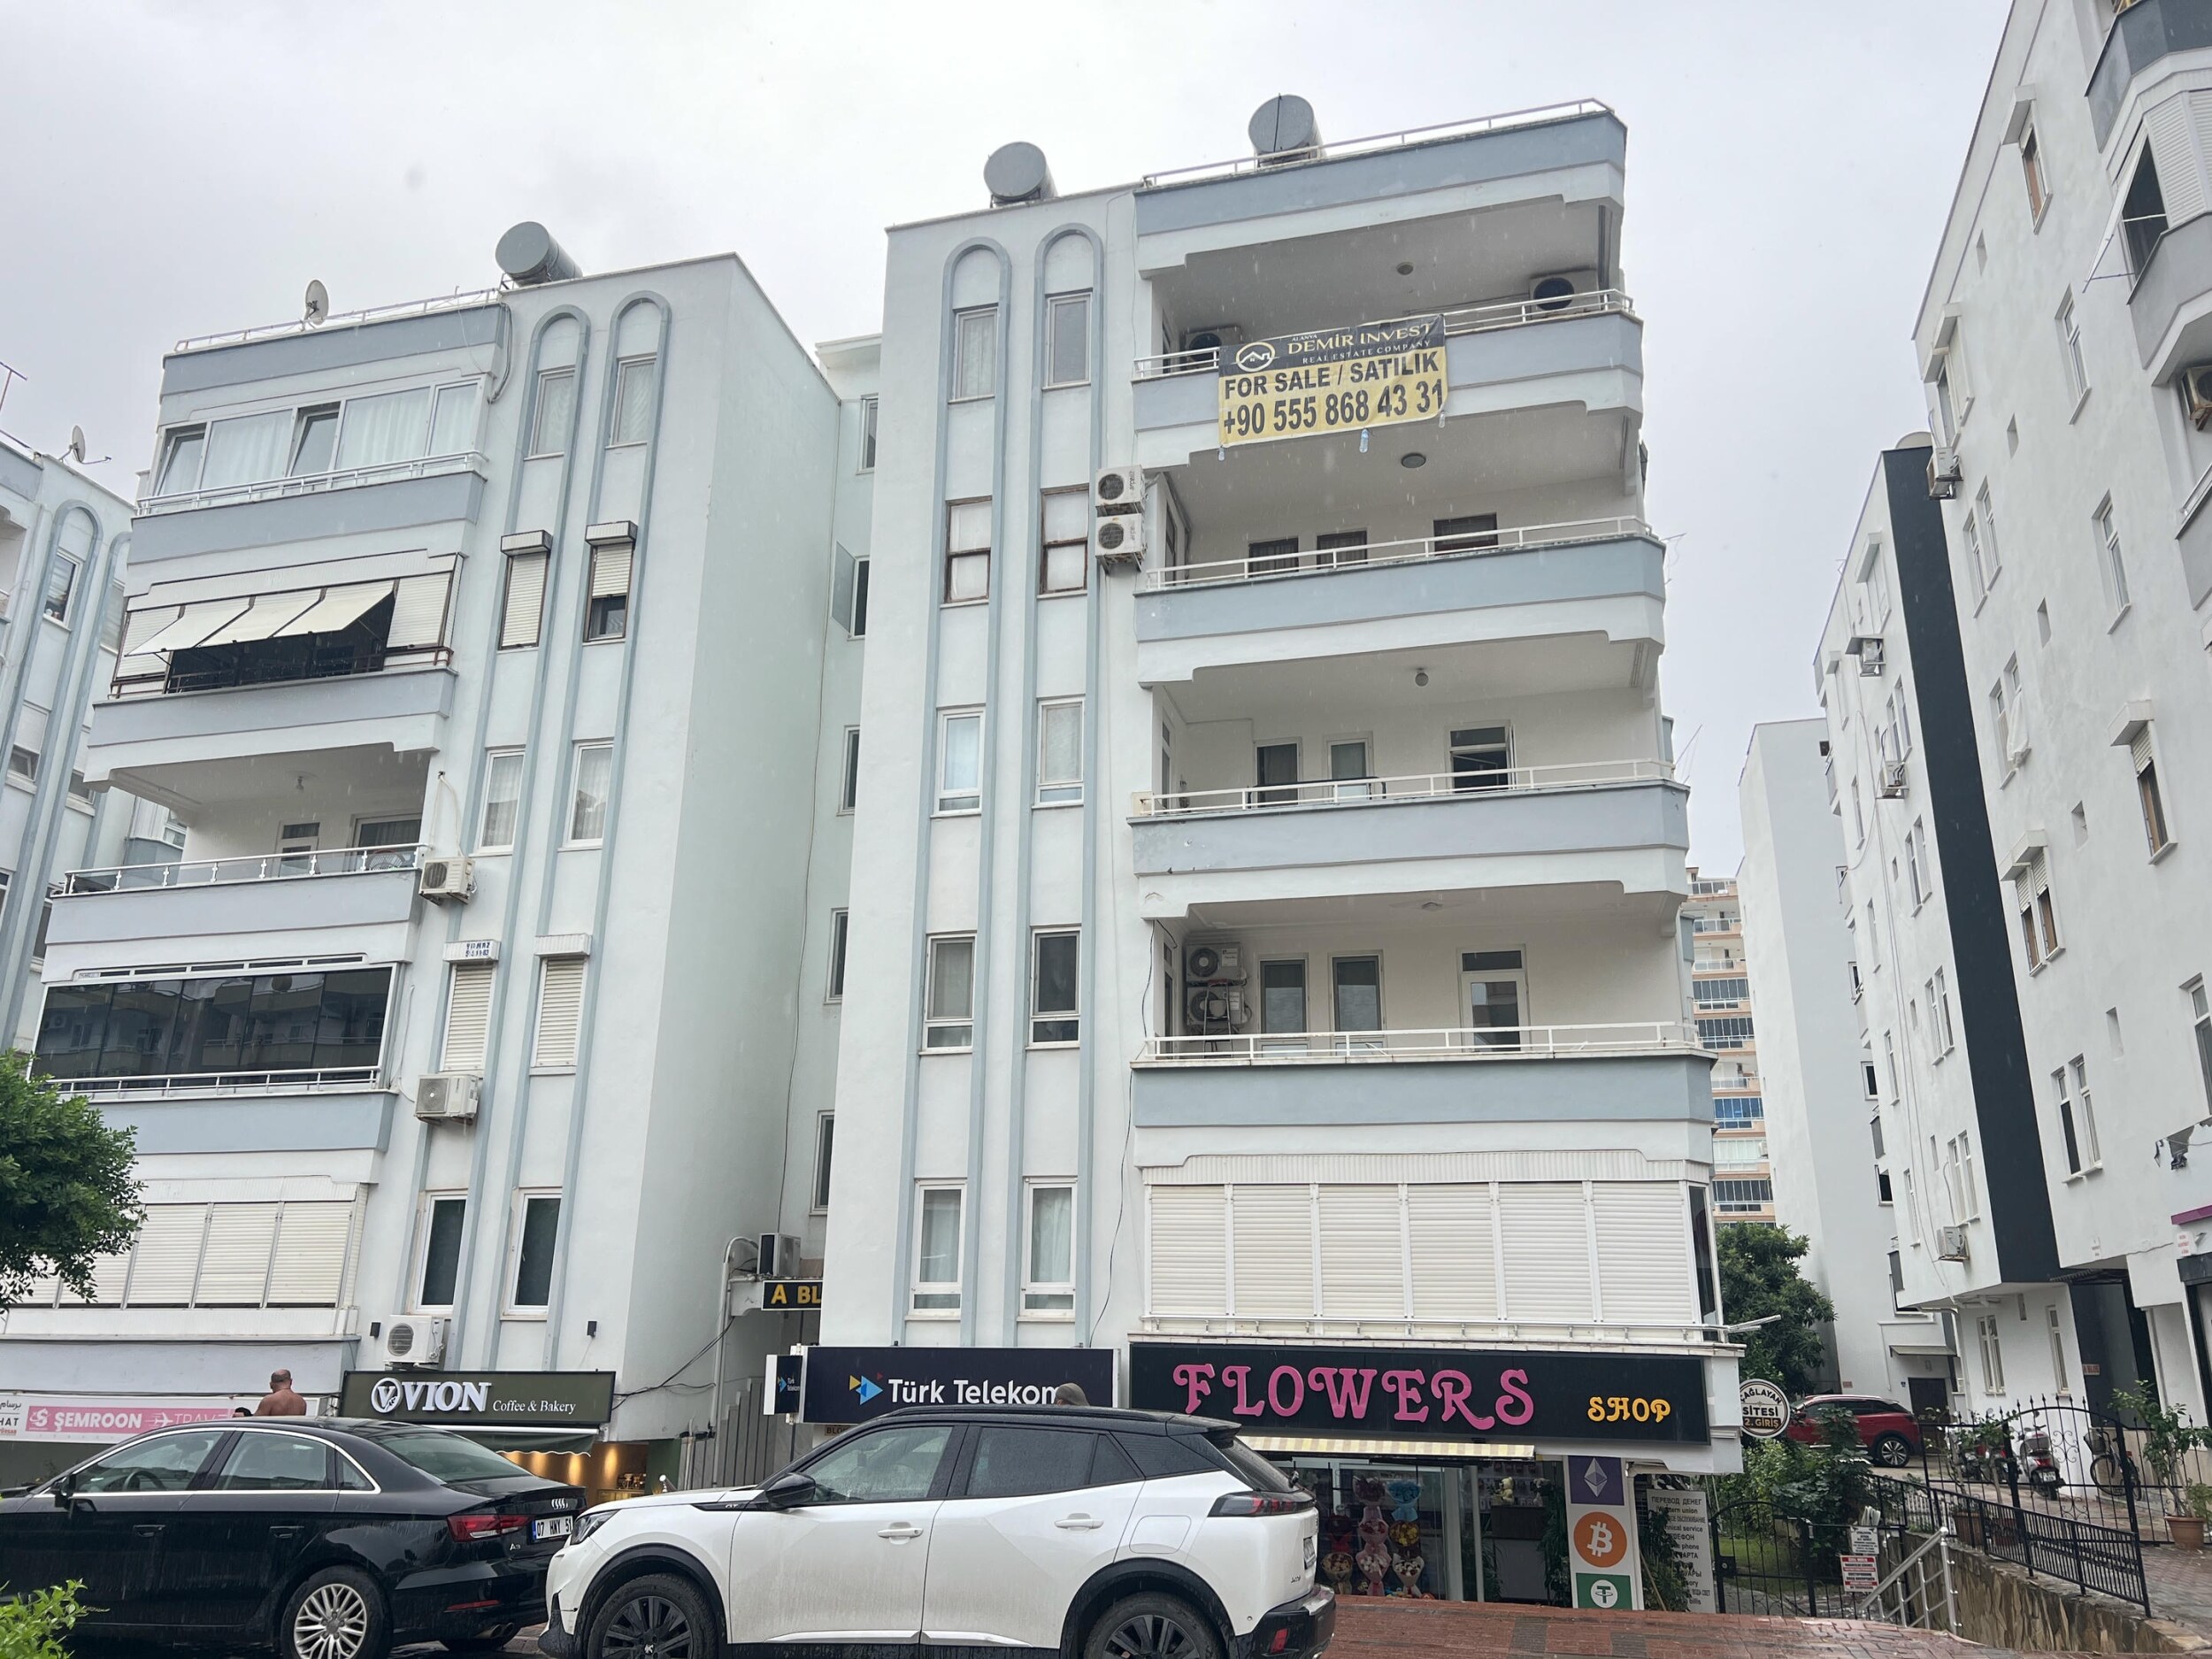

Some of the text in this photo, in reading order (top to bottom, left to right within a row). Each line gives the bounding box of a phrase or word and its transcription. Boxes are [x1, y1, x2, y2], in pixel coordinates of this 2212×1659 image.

[1287, 323, 1432, 355] DEMİR INVEST
[1302, 340, 1431, 365] REAL ESTATE COMPANY
[1225, 375, 1267, 399] FOR
[1274, 367, 1331, 392] SALE
[1350, 351, 1439, 383] SATILIK
[1224, 378, 1443, 436] +90 555 868 43 31
[771, 1283, 822, 1304] A BL
[402, 1380, 492, 1412] VION
[493, 1399, 526, 1412] Coffee
[527, 1400, 538, 1412] &
[540, 1400, 576, 1415] Bakery
[887, 1379, 945, 1404] Türk
[1173, 1363, 1671, 1431] FLOWERS SHOP
[54, 1412, 142, 1432] ŞEMROON
[537, 1521, 545, 1537] 07
